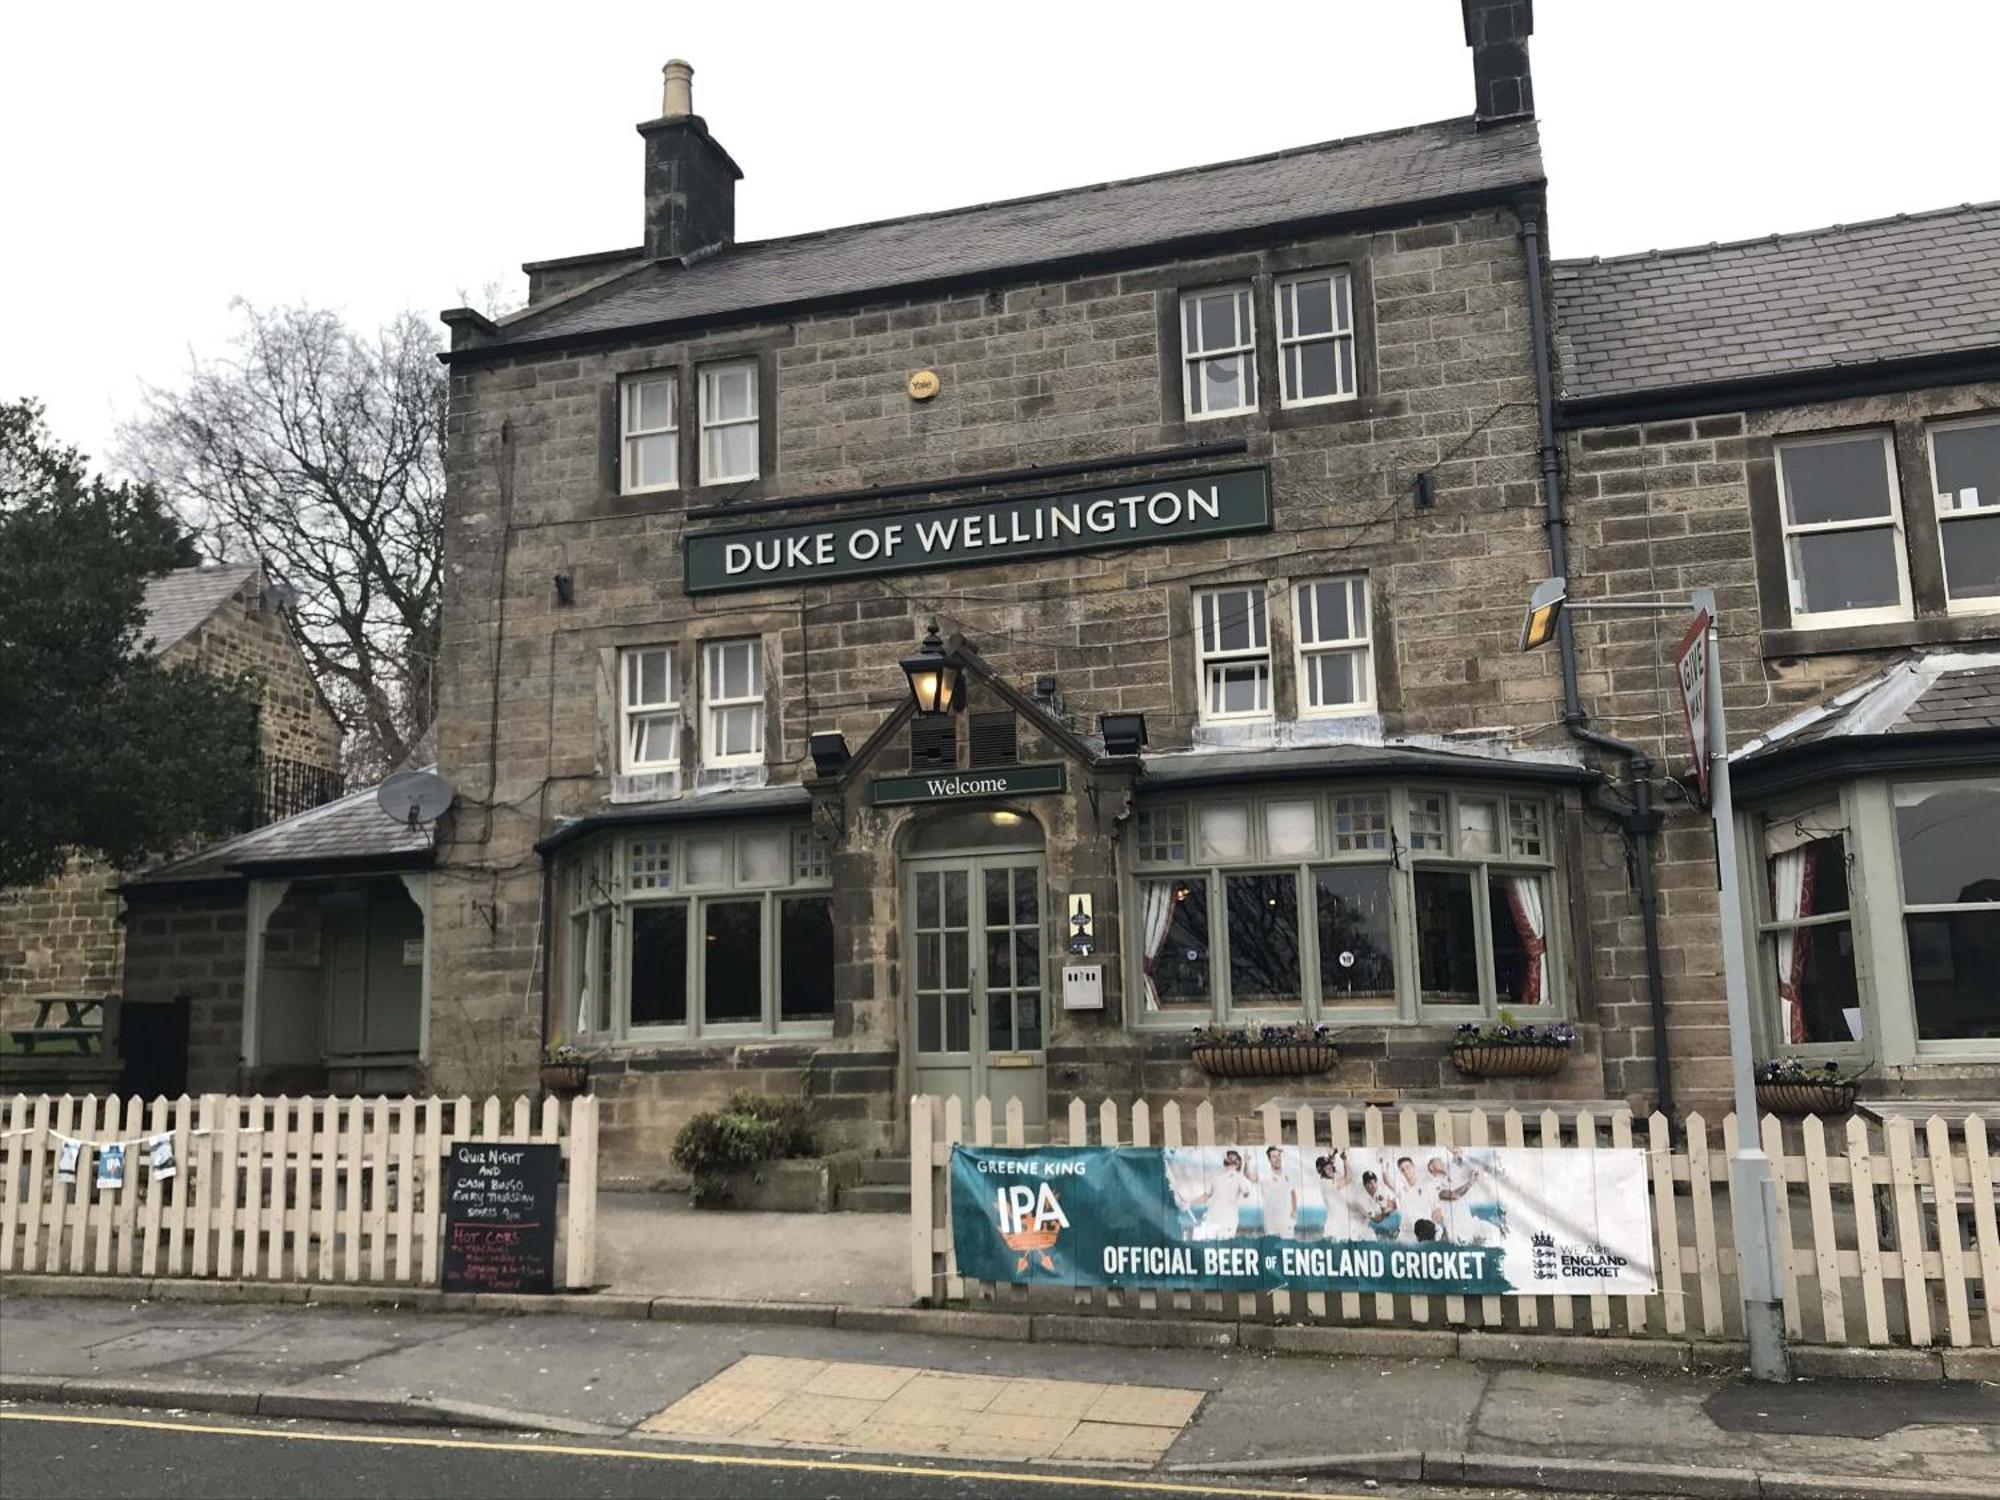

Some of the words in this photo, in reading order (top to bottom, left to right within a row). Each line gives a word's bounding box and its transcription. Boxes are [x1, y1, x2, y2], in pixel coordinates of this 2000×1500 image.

[726, 533, 836, 575] DUKE
[848, 525, 902, 560] OF
[916, 486, 1219, 552] WELLINGTON
[1684, 640, 1704, 691] GIVE
[927, 776, 1007, 796] Welcome
[488, 1149, 525, 1165] NIGHT
[479, 1165, 501, 1176] AND
[977, 1160, 1037, 1175] GREENE
[1044, 1161, 1087, 1176] KING
[457, 1178, 485, 1190] CASH
[491, 1179, 524, 1191] BINGO
[997, 1181, 1070, 1234] IPA
[1560, 1244, 1579, 1255] WE
[1585, 1245, 1611, 1255] ARE
[1103, 1246, 1198, 1275] OFFICIAL
[1204, 1248, 1260, 1277] BEER
[1264, 1254, 1278, 1270] OF
[1283, 1248, 1385, 1279] ENGLAND
[1391, 1251, 1486, 1281] CRICKET
[1561, 1255, 1628, 1267] ENGLAND
[1561, 1266, 1620, 1278] CRICKET
